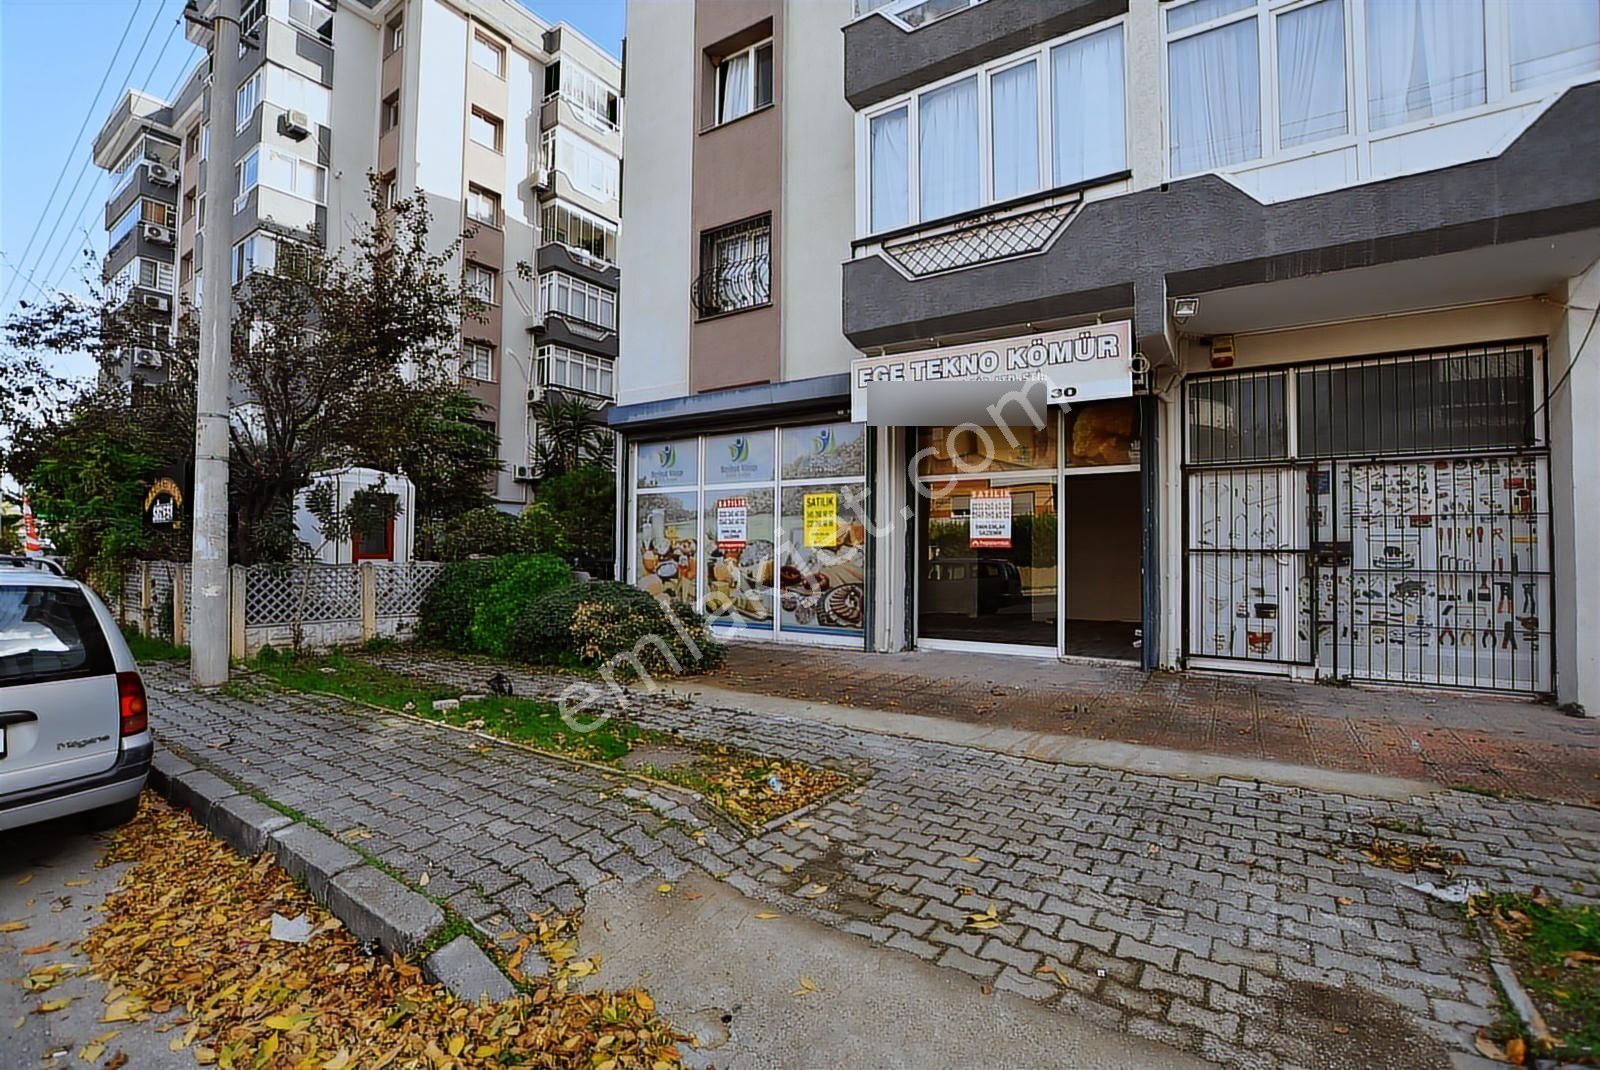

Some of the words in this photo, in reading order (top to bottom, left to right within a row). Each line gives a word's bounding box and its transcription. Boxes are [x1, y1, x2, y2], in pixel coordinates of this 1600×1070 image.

[858, 364, 905, 388] EGE
[911, 351, 1000, 381] TEKNO
[1007, 331, 1119, 370] KÖMÜR
[806, 497, 834, 507] SATILIK
